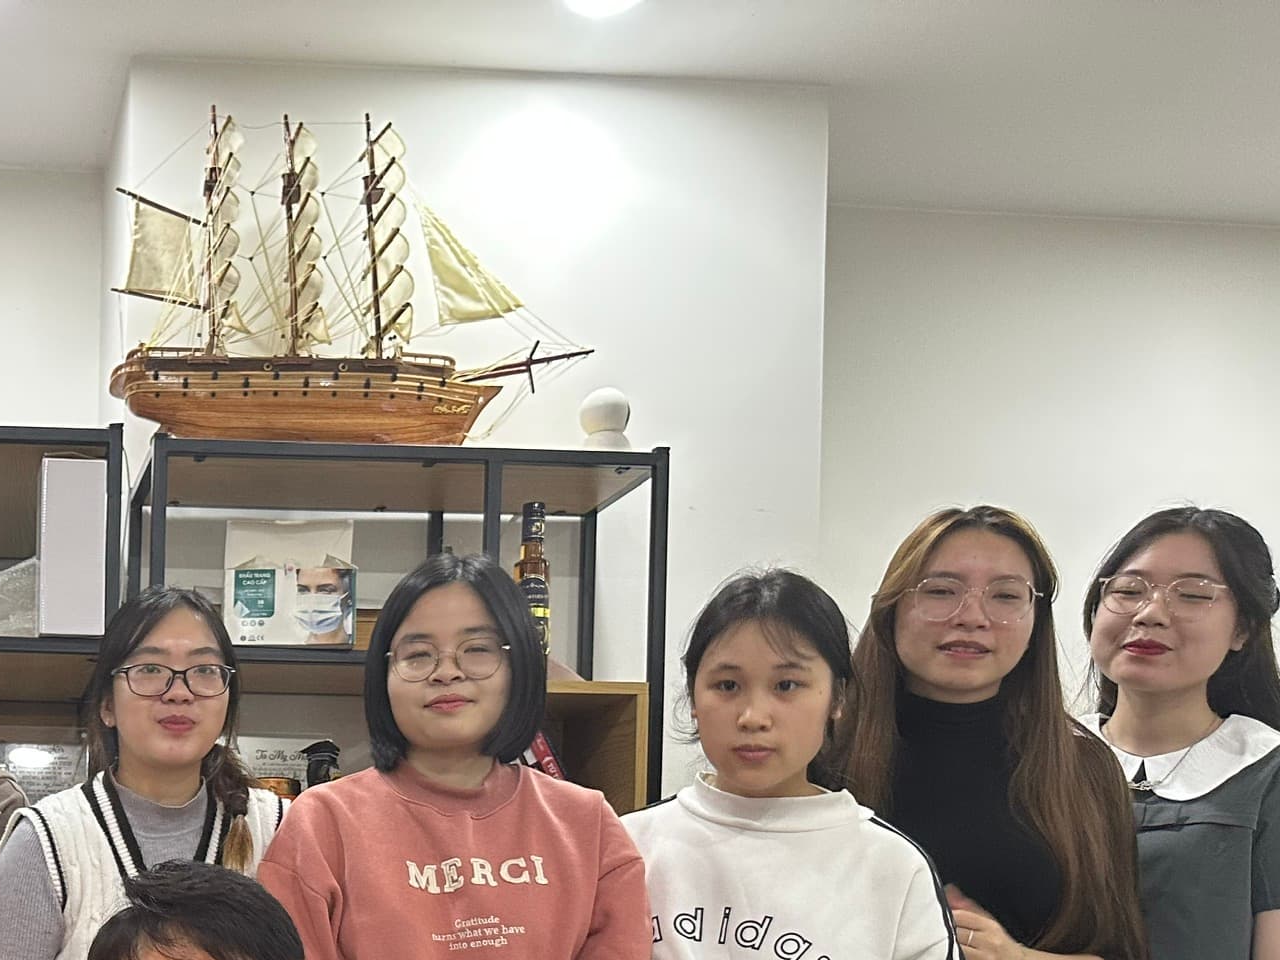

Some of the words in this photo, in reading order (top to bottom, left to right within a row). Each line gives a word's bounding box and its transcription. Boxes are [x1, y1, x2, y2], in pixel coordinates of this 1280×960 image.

[255, 749, 268, 761] To
[406, 855, 549, 894] MERCI
[454, 915, 500, 928] Gratitude
[459, 928, 482, 938] what
[484, 927, 499, 935] we
[500, 924, 526, 935] have
[448, 941, 468, 951] into
[470, 935, 508, 948] enough
